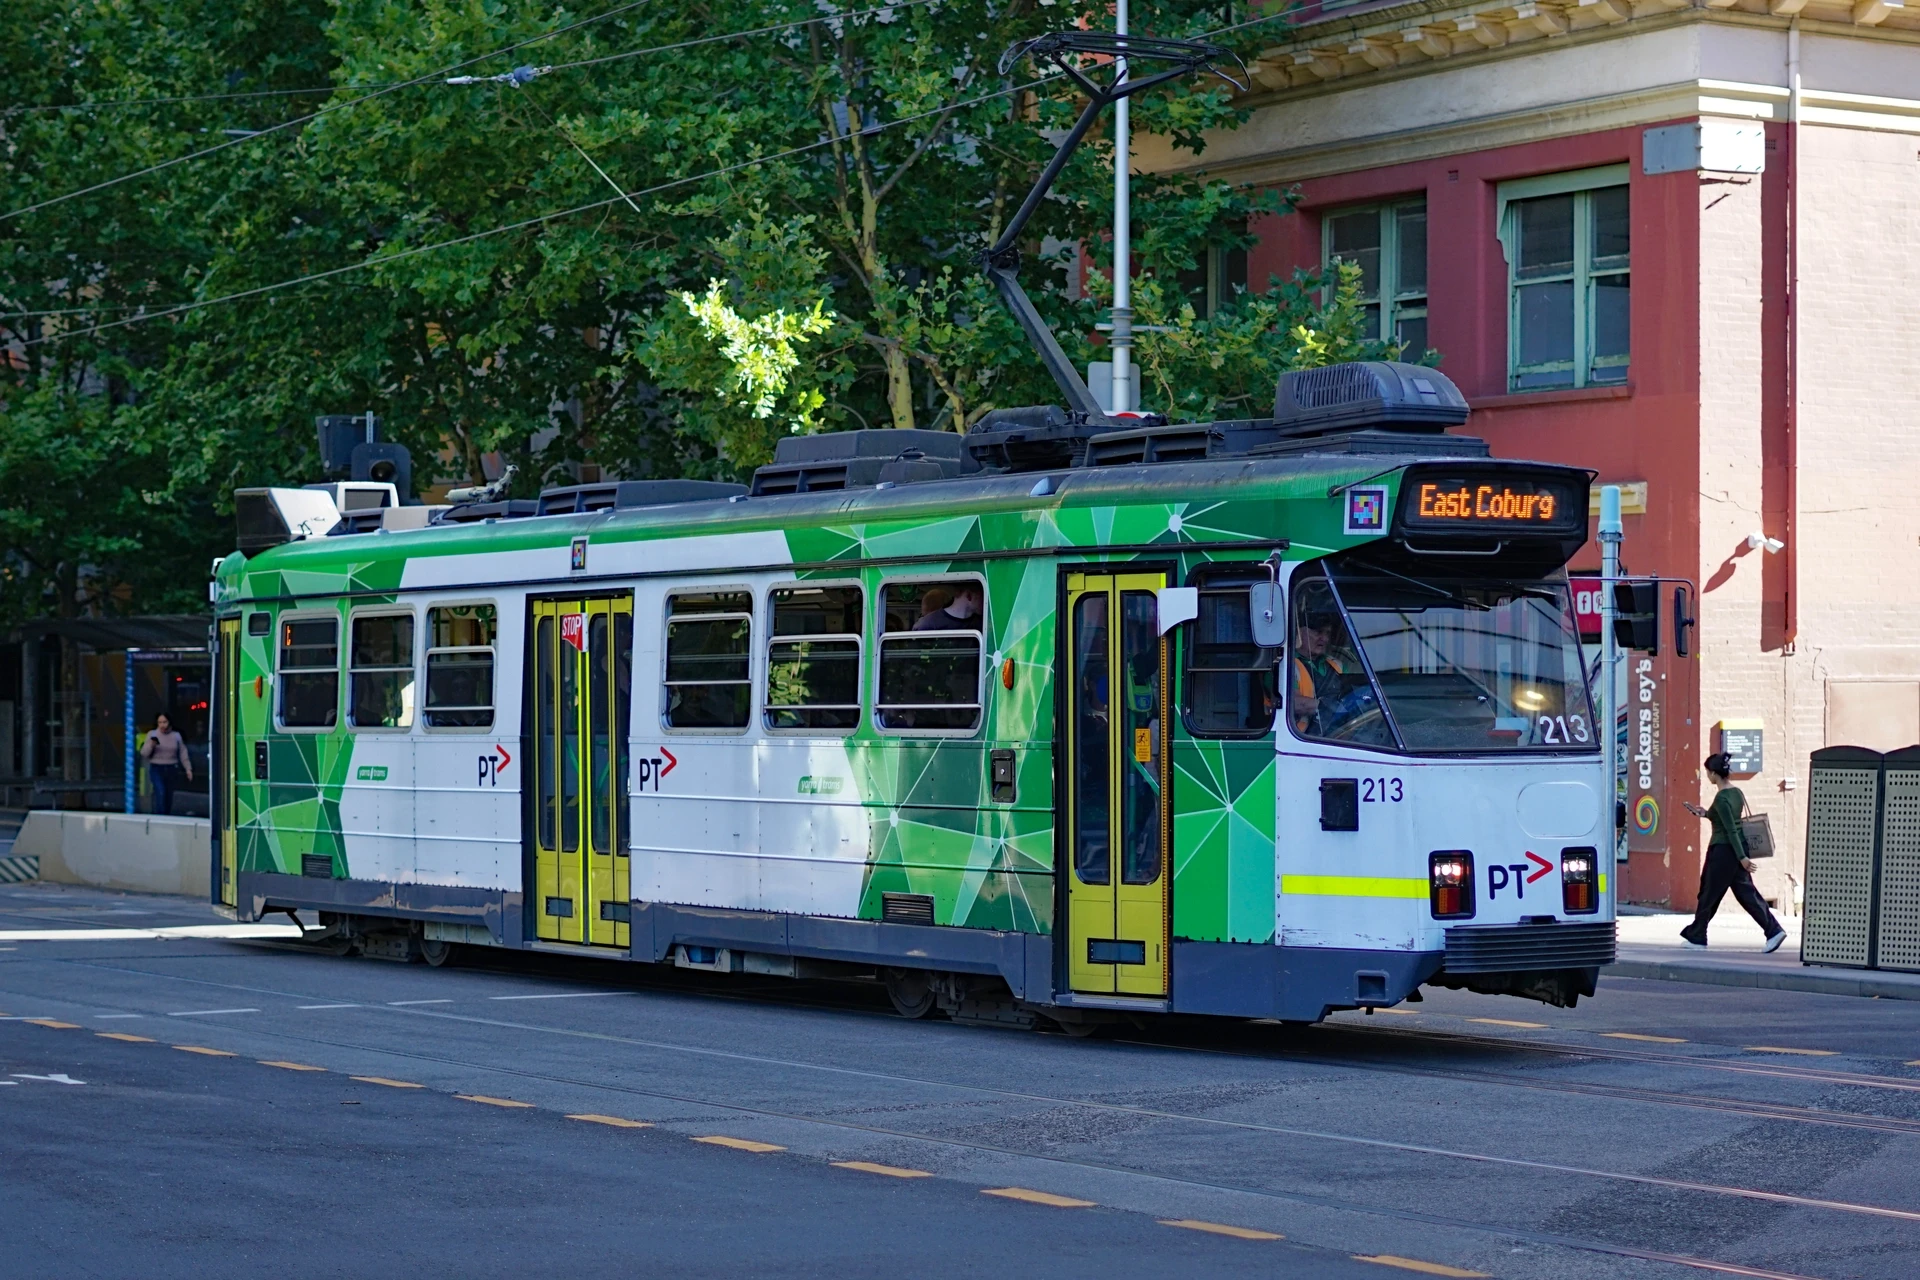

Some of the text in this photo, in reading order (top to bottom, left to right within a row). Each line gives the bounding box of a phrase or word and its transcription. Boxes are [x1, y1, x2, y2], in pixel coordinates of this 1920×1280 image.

[1420, 484, 1554, 519] East Coburg
[562, 616, 582, 636] STOP
[1652, 701, 1660, 729] CRAFT
[1539, 714, 1589, 744] 213
[1652, 738, 1660, 757] ART
[1362, 777, 1404, 803] 213
